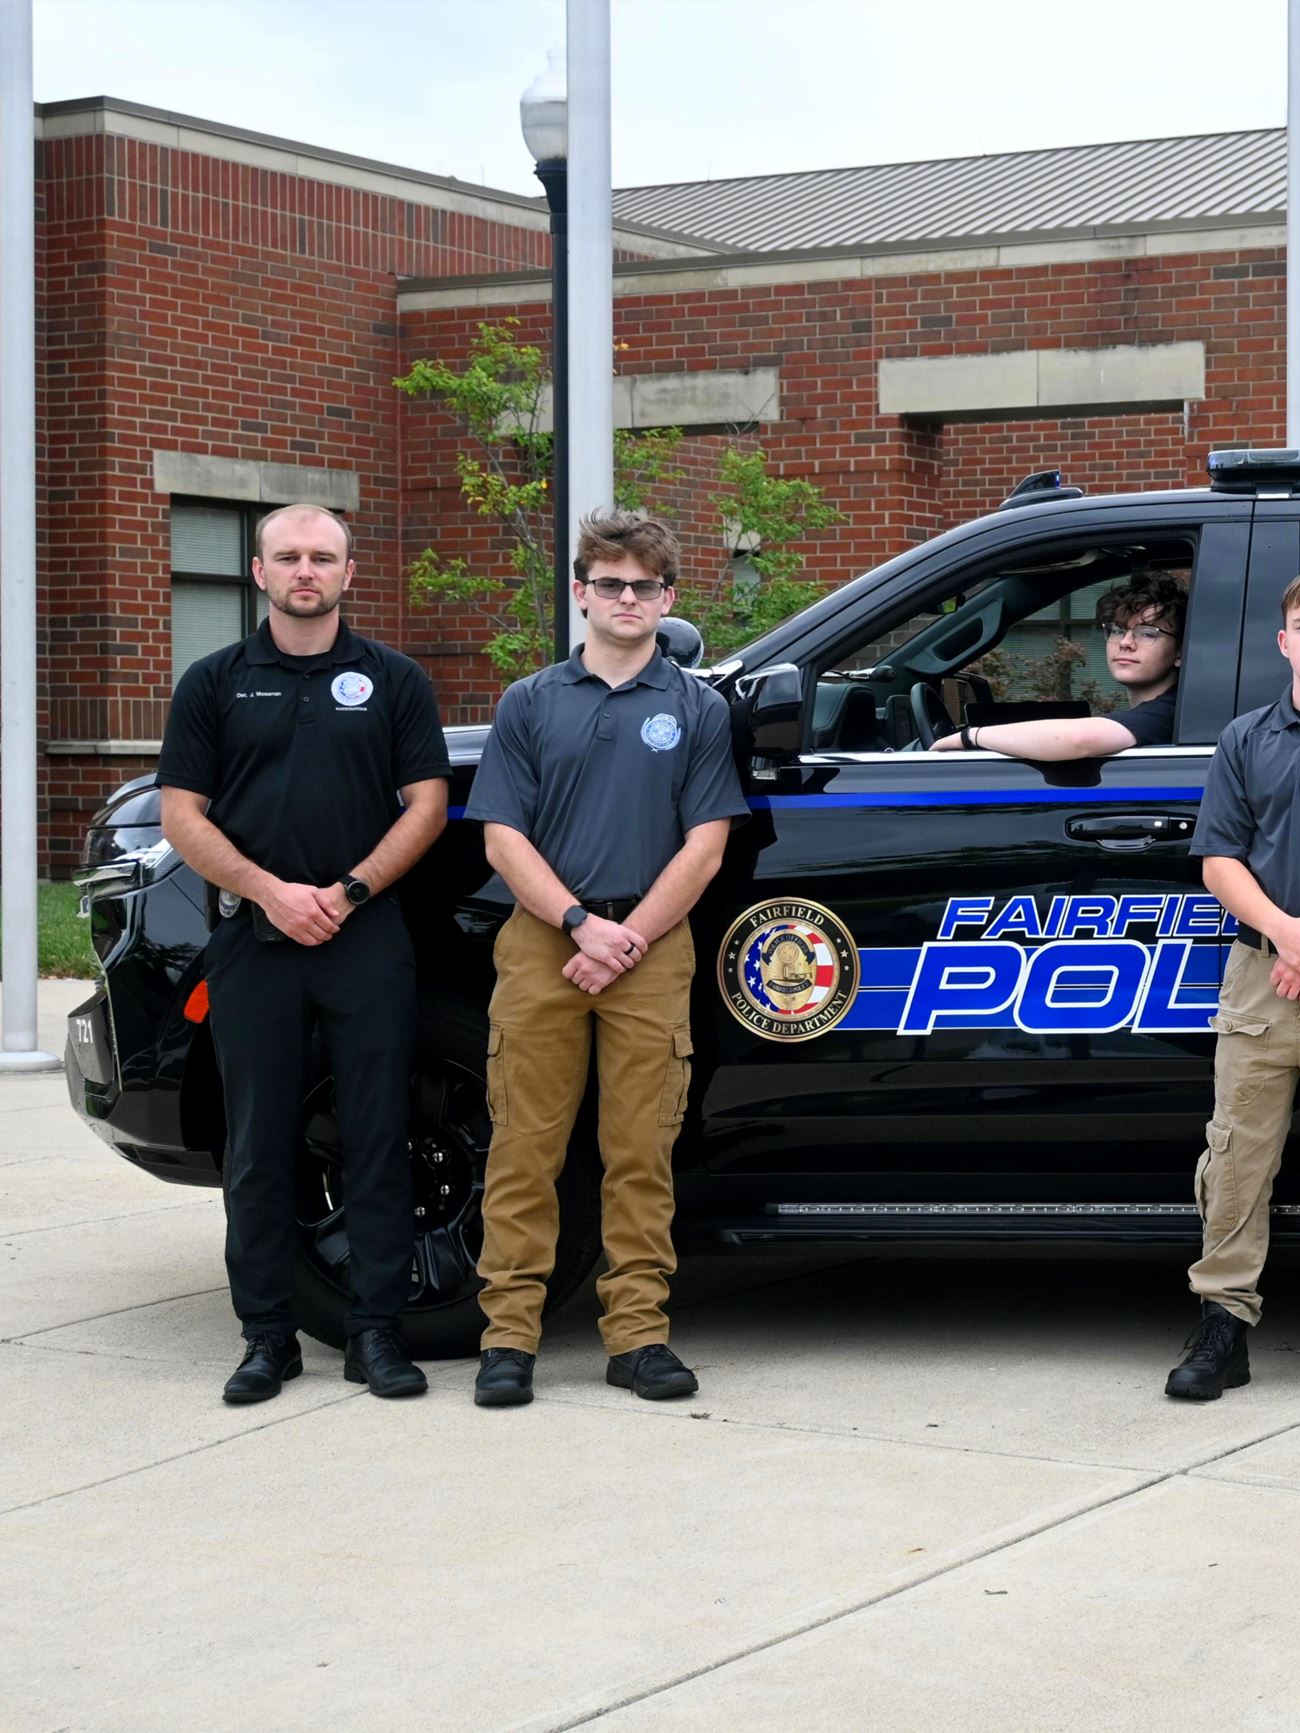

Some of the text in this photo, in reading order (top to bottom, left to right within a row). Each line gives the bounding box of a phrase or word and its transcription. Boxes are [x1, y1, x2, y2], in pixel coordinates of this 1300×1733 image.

[750, 905, 825, 928] FAIRFIELD
[937, 893, 1240, 939] FAIRFIE
[731, 990, 847, 1035] POLICE DEPARTMENT
[76, 1018, 94, 1044] 721
